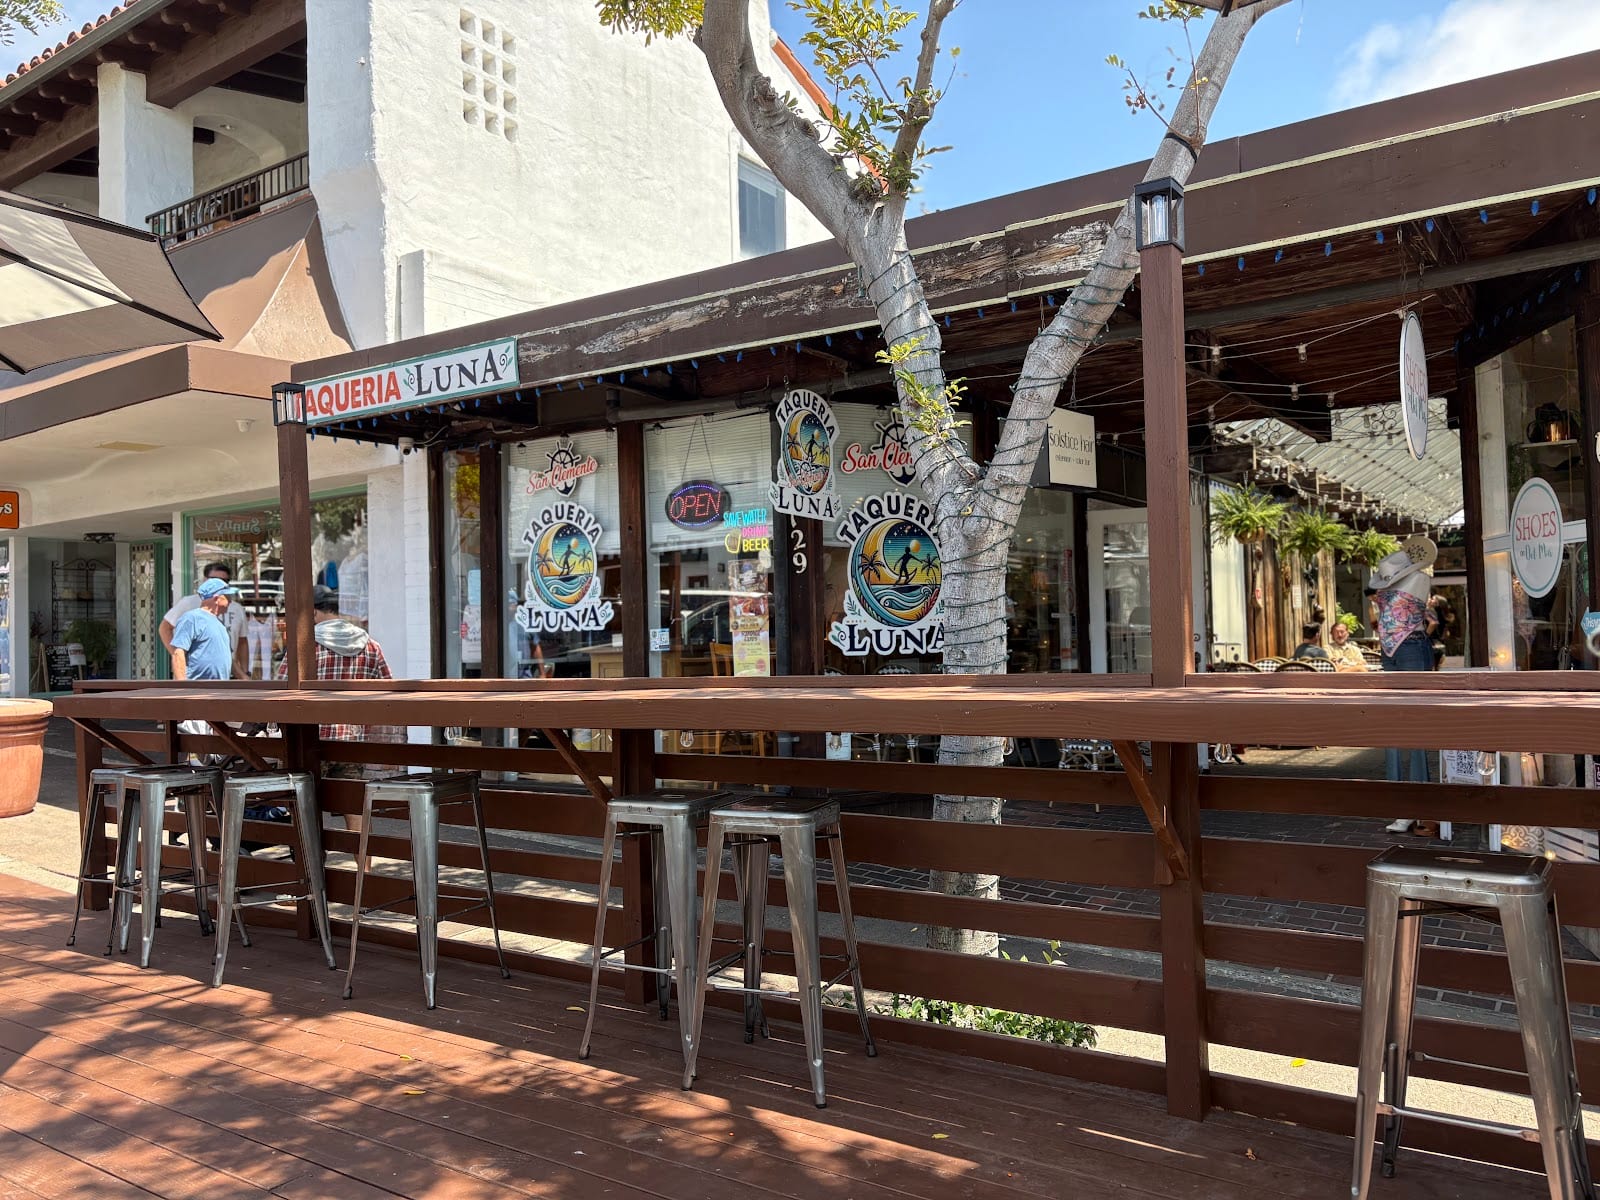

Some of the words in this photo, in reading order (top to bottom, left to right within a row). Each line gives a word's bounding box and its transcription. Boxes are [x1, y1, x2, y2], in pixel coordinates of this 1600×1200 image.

[294, 370, 402, 419] TAQUERIA
[414, 348, 503, 397] LUNA
[777, 391, 835, 440] TAQUERIA
[842, 444, 878, 472] San
[526, 471, 549, 495] San
[551, 456, 597, 487] Clemente
[669, 491, 722, 521] OPEN
[778, 486, 834, 518] LUNA
[523, 503, 602, 546] TAQUERIA
[723, 510, 742, 528] SAVE
[742, 508, 767, 526] WATER
[742, 525, 769, 538] DRINK
[839, 494, 942, 548] TAQUERI
[1515, 510, 1557, 541] SHOES
[742, 537, 769, 552] BEER
[526, 604, 602, 630] LUNA
